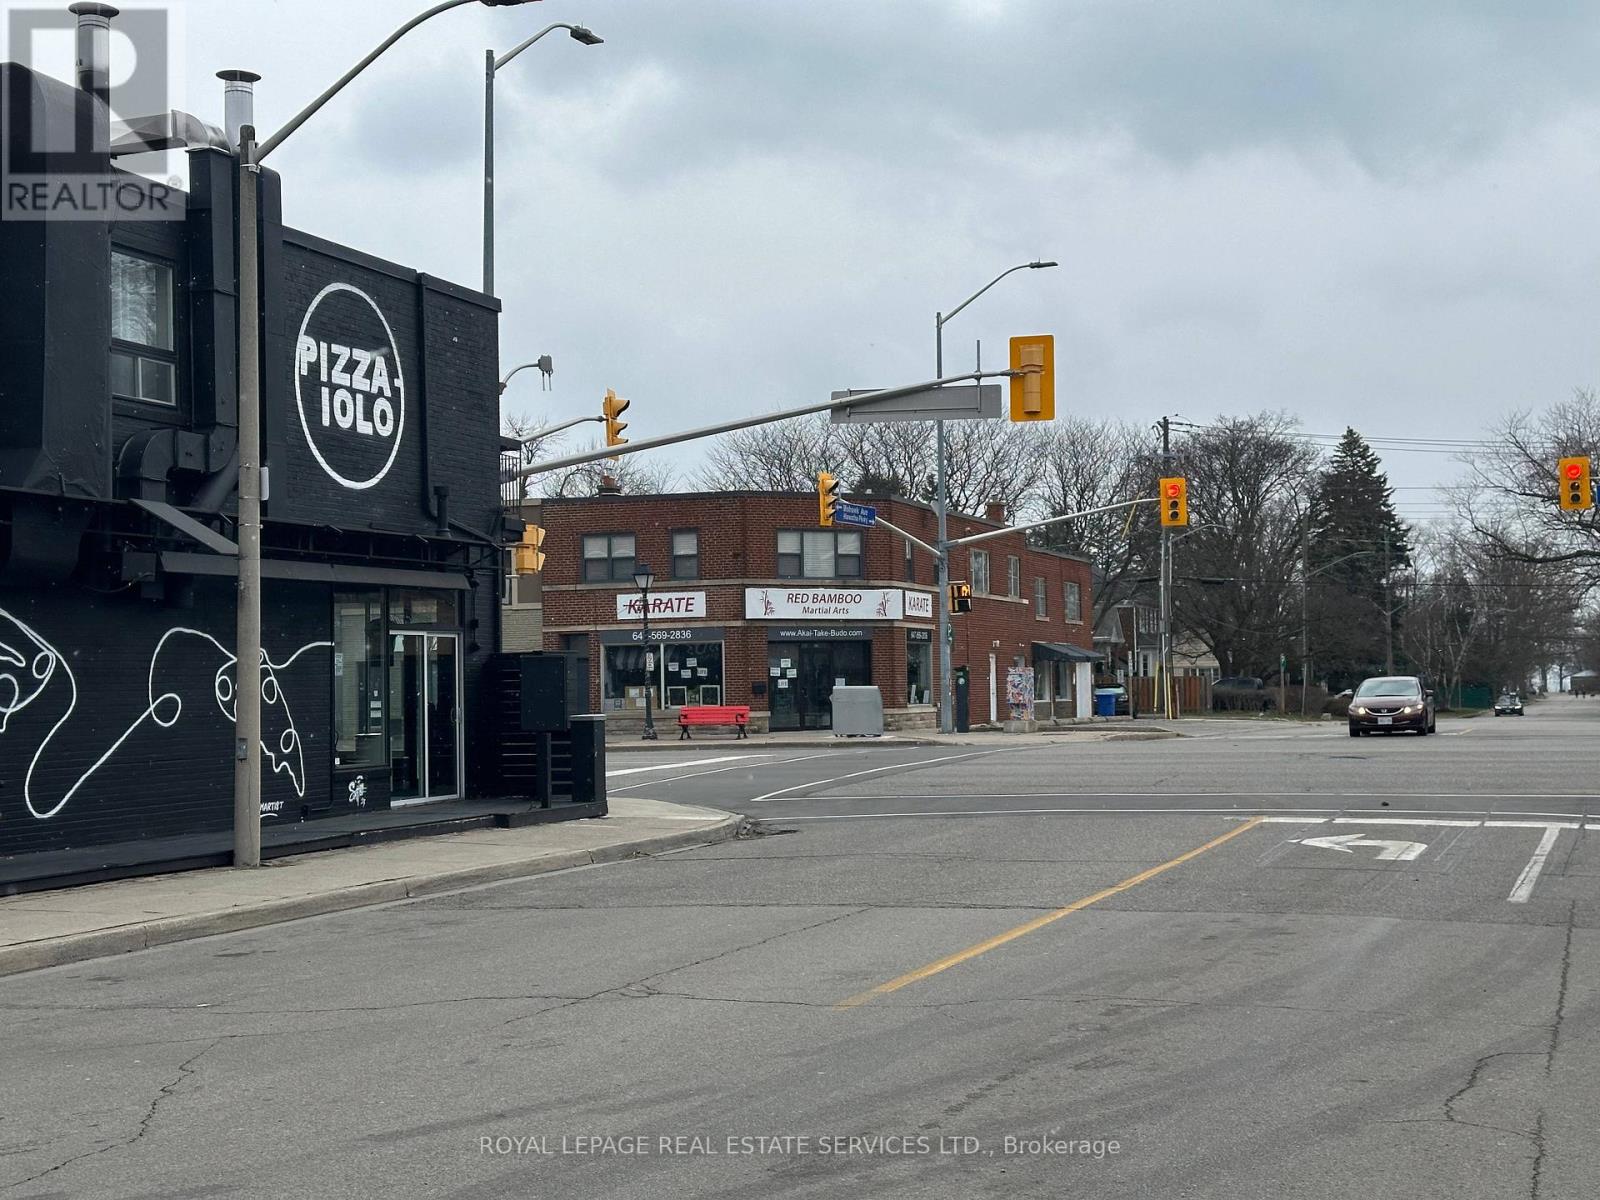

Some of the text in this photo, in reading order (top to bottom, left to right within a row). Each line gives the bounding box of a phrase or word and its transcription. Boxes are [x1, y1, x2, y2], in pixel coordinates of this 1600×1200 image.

[321, 386, 394, 437] IOLO
[786, 593, 862, 604] RED BAMBOO
[908, 595, 929, 612] KARATE
[802, 606, 849, 615] Martial Arts
[632, 630, 692, 640] 64-569-2836
